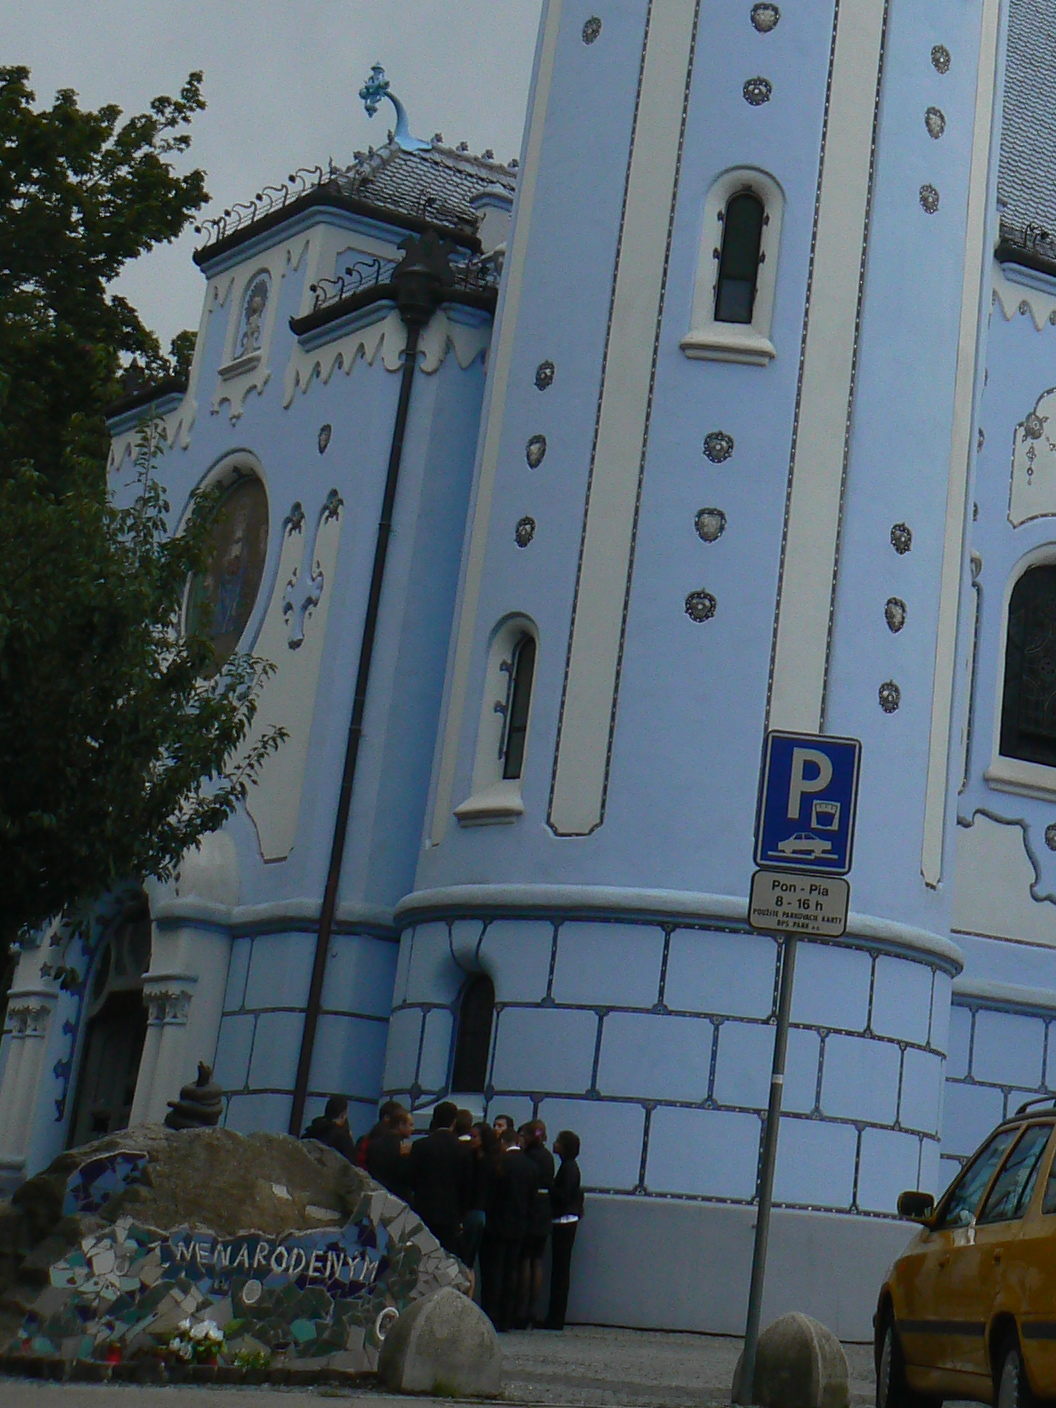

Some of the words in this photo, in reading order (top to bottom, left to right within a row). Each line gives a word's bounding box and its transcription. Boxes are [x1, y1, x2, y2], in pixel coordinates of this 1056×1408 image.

[786, 746, 833, 820] P
[771, 879, 796, 893] Pon
[809, 883, 829, 897] Pia
[775, 895, 784, 907] 8
[797, 898, 810, 910] 16
[815, 900, 823, 911] h
[792, 921, 810, 930] PARK
[821, 915, 842, 925] KARTY
